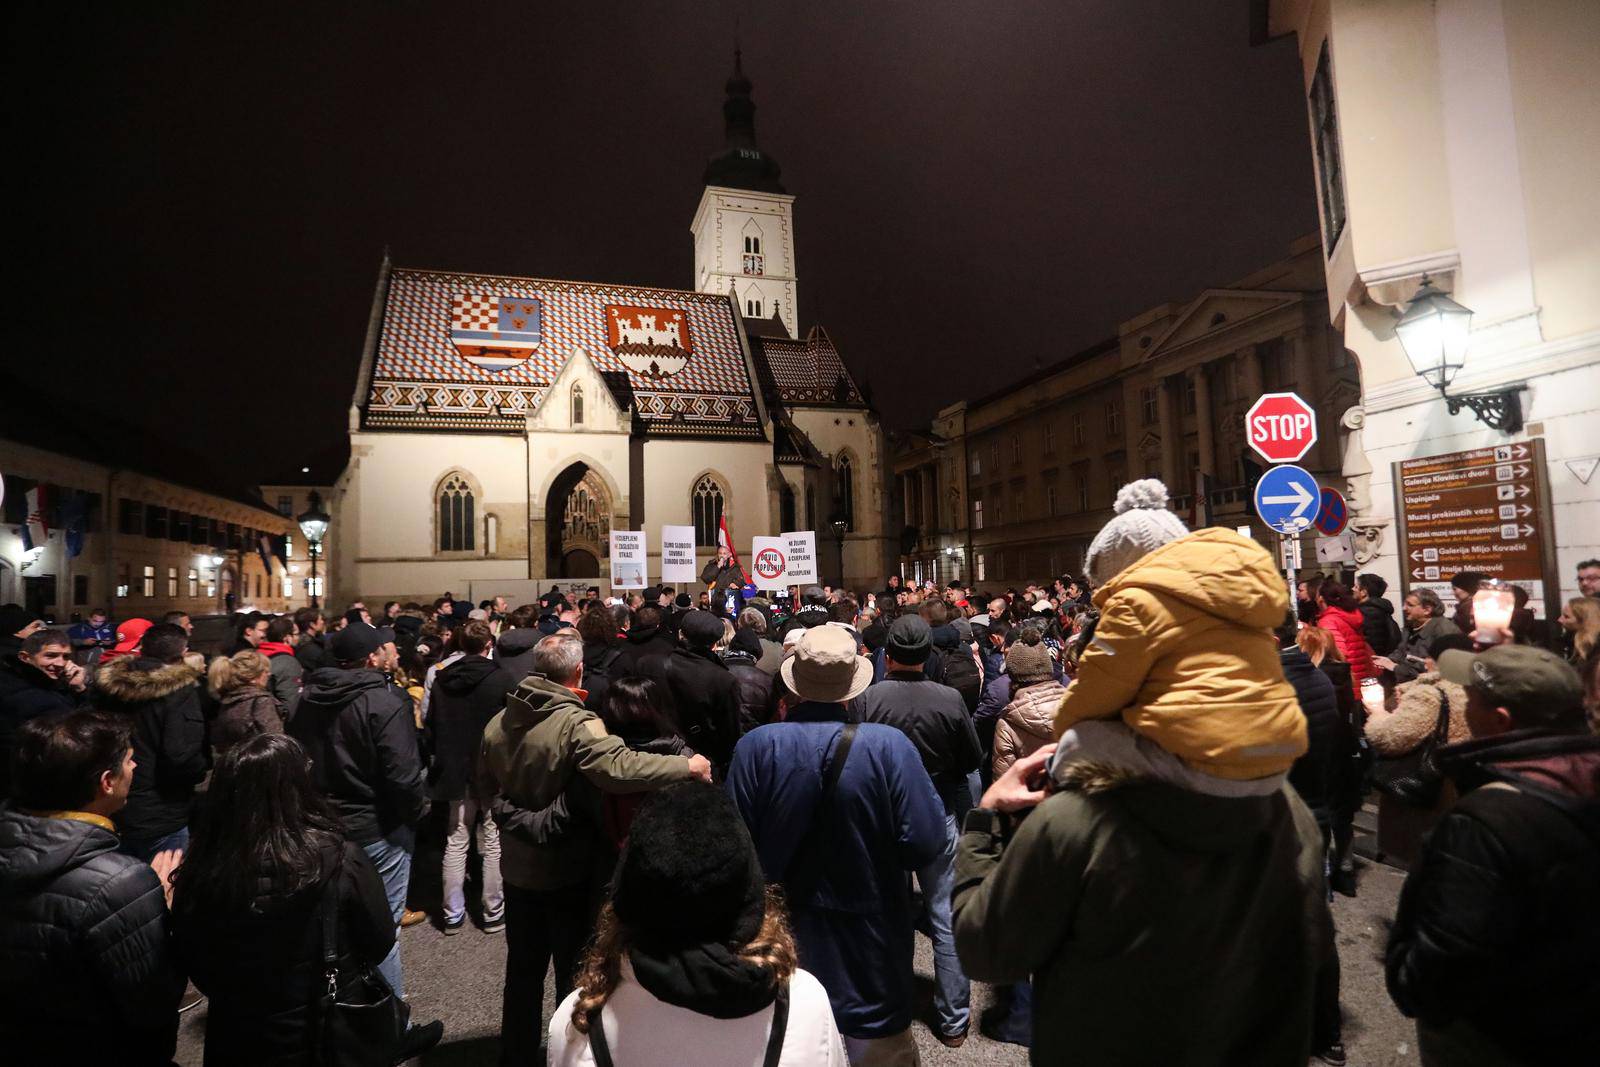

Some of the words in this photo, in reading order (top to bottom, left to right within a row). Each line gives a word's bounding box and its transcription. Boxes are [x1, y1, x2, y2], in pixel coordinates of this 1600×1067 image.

[1254, 414, 1310, 442] STOP
[1404, 478, 1432, 486] Galerija
[1468, 469, 1488, 478] dvori
[1432, 510, 1472, 519] prekinutih
[1439, 546, 1470, 555] Galerija
